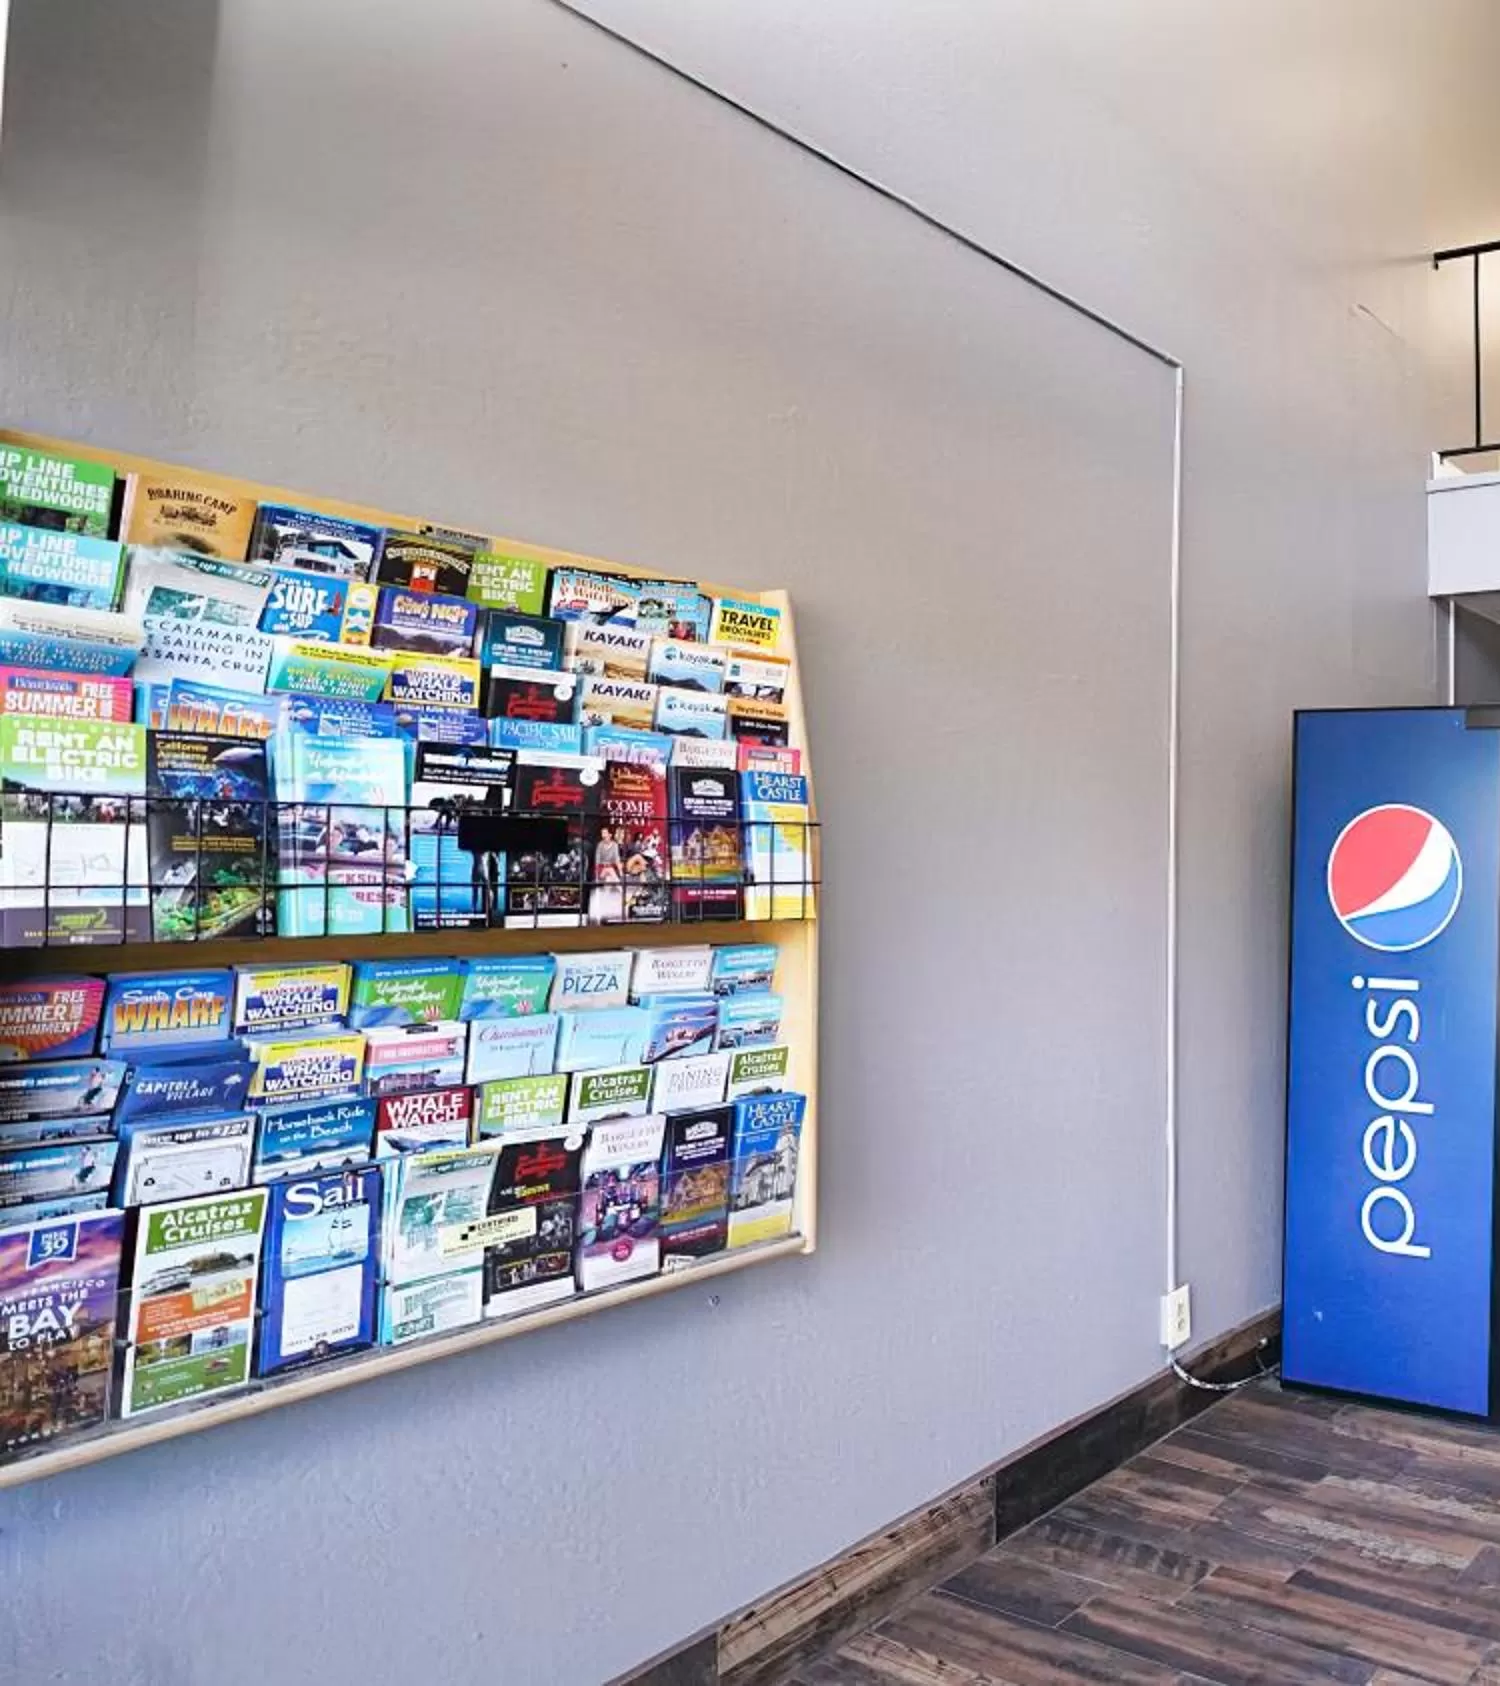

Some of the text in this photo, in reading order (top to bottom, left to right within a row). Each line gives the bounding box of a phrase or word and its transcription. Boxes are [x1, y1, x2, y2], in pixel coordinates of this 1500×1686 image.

[26, 456, 76, 478] LINE
[0, 468, 110, 499] DVENTURES
[27, 532, 77, 554] LINE
[0, 544, 113, 575] DVENTURES
[510, 566, 533, 581] AN
[269, 584, 329, 616] SURF
[721, 609, 774, 632] TRAVEL
[160, 621, 271, 648] CATAMARAN
[584, 630, 645, 650] KAYAK!
[163, 635, 234, 658] SAILING
[221, 660, 266, 676] CRUZ
[81, 682, 115, 699] FREE
[391, 686, 472, 705] WATCHING
[5, 690, 96, 717] SUMMER
[17, 729, 135, 752] RENT AN
[11, 744, 139, 768] ELECTRIC
[46, 764, 108, 782] BIKE
[754, 772, 802, 788] HEARST
[756, 785, 802, 801] CASTLE
[606, 799, 654, 814] COME
[562, 973, 620, 995] PIZZA
[52, 989, 88, 1005] FREE
[122, 988, 172, 1005] Santa
[261, 990, 323, 1007] WHALE
[0, 1003, 66, 1024] MMER
[113, 997, 225, 1034] WHARF
[246, 1001, 336, 1022] WATCHING
[281, 1060, 342, 1078] WHALE
[739, 1051, 785, 1066] Alcatraz
[135, 1079, 199, 1096] CAPITOLA
[265, 1069, 353, 1092] WATCHING
[588, 1073, 643, 1091] Alcatraz
[385, 1092, 465, 1114] WHALE
[535, 1087, 559, 1099] AN
[589, 1086, 639, 1101] Cruises
[387, 1107, 459, 1129] WATCH
[748, 1100, 800, 1117] HEARST
[1351, 975, 1435, 1259] pepsi
[750, 1110, 796, 1129] CASTLE
[310, 1123, 353, 1139] Beach
[283, 1180, 366, 1221] Sail
[160, 1200, 253, 1230] Alcatraz
[163, 1216, 246, 1242] Cruises
[38, 1238, 69, 1258] 39
[1, 1288, 89, 1317] MEETS THE
[8, 1301, 82, 1341] BAY
